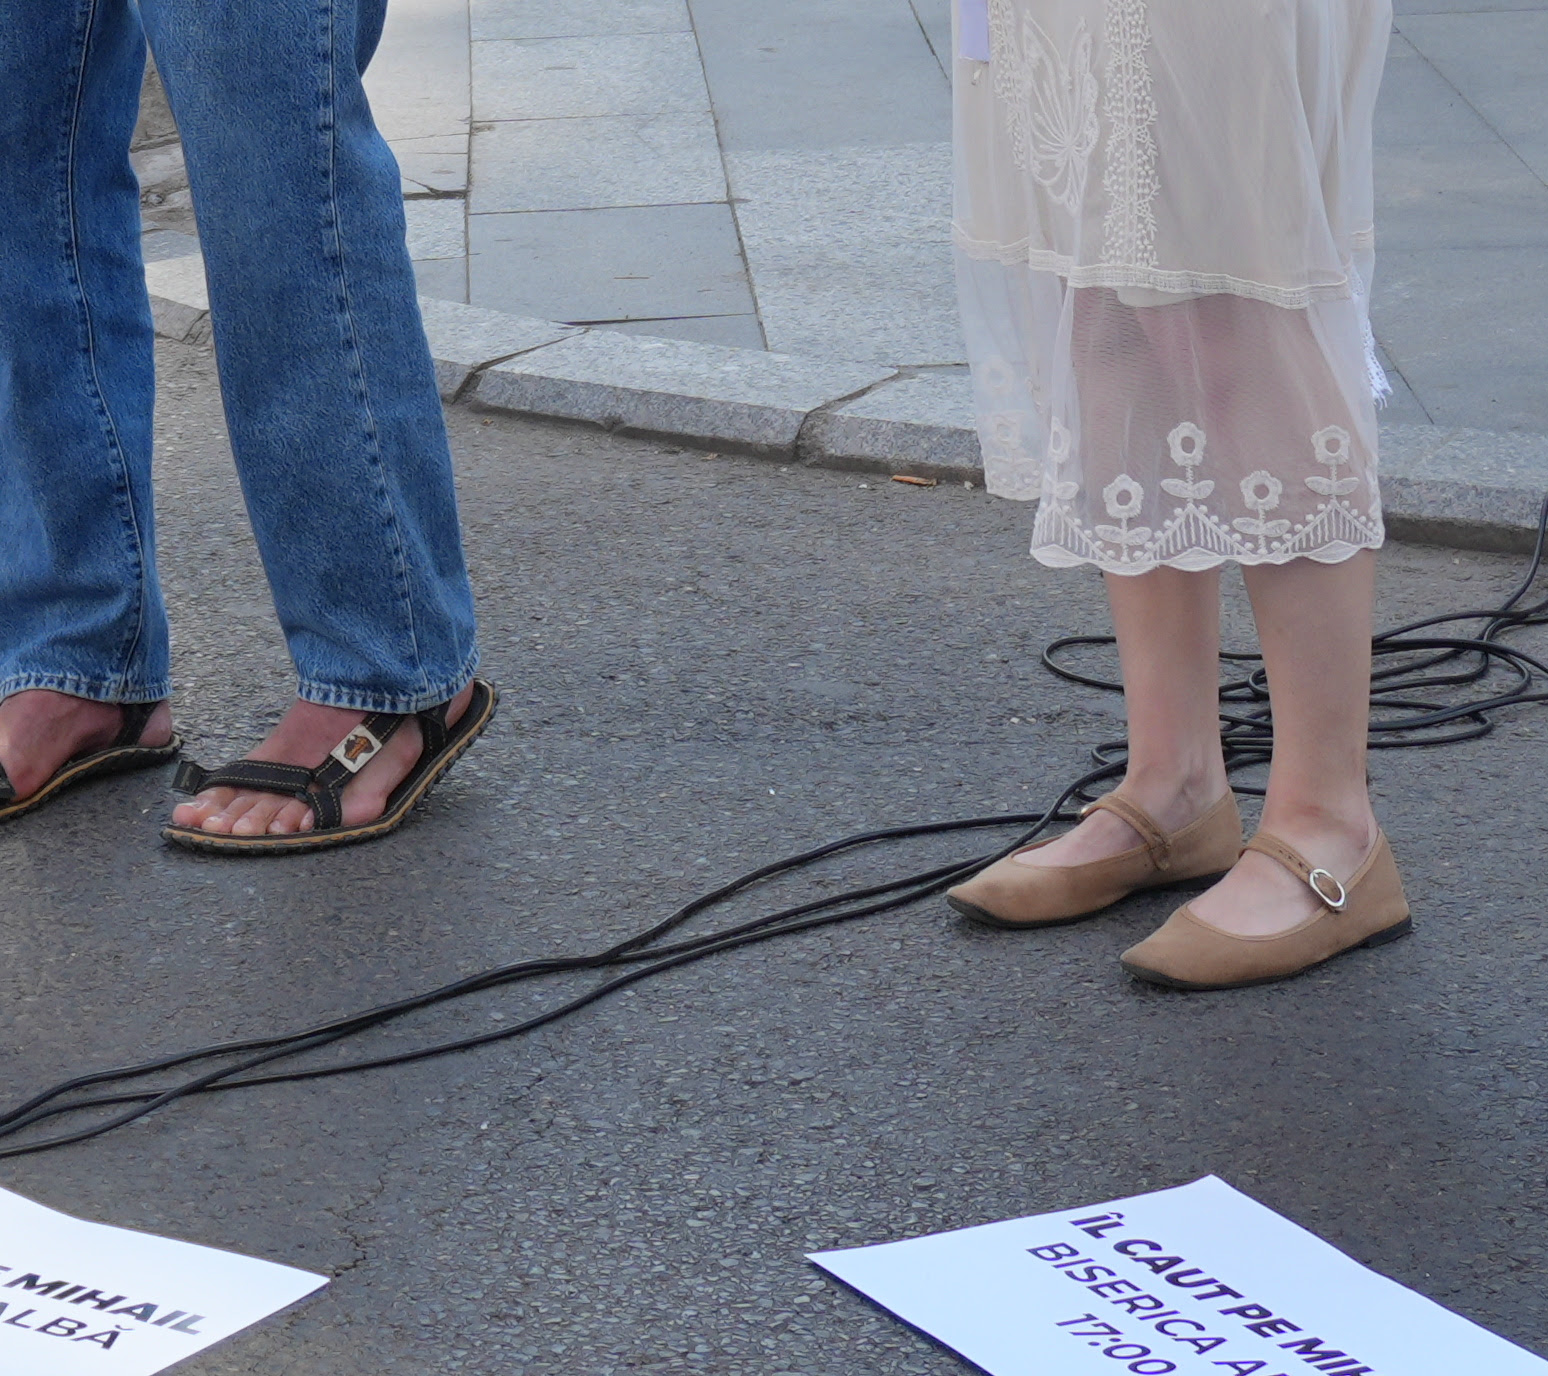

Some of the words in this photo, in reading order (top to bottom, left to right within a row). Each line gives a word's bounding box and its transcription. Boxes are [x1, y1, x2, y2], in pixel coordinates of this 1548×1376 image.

[2, 1272, 210, 1336] MIHAIL
[1025, 1242, 1229, 1356] BISERICA
[1210, 1360, 1290, 1376] A
[1068, 1211, 1125, 1240] ÎL
[1112, 1238, 1246, 1301] CAUT
[1217, 1303, 1305, 1339] PE
[1054, 1312, 1177, 1376] 17:00
